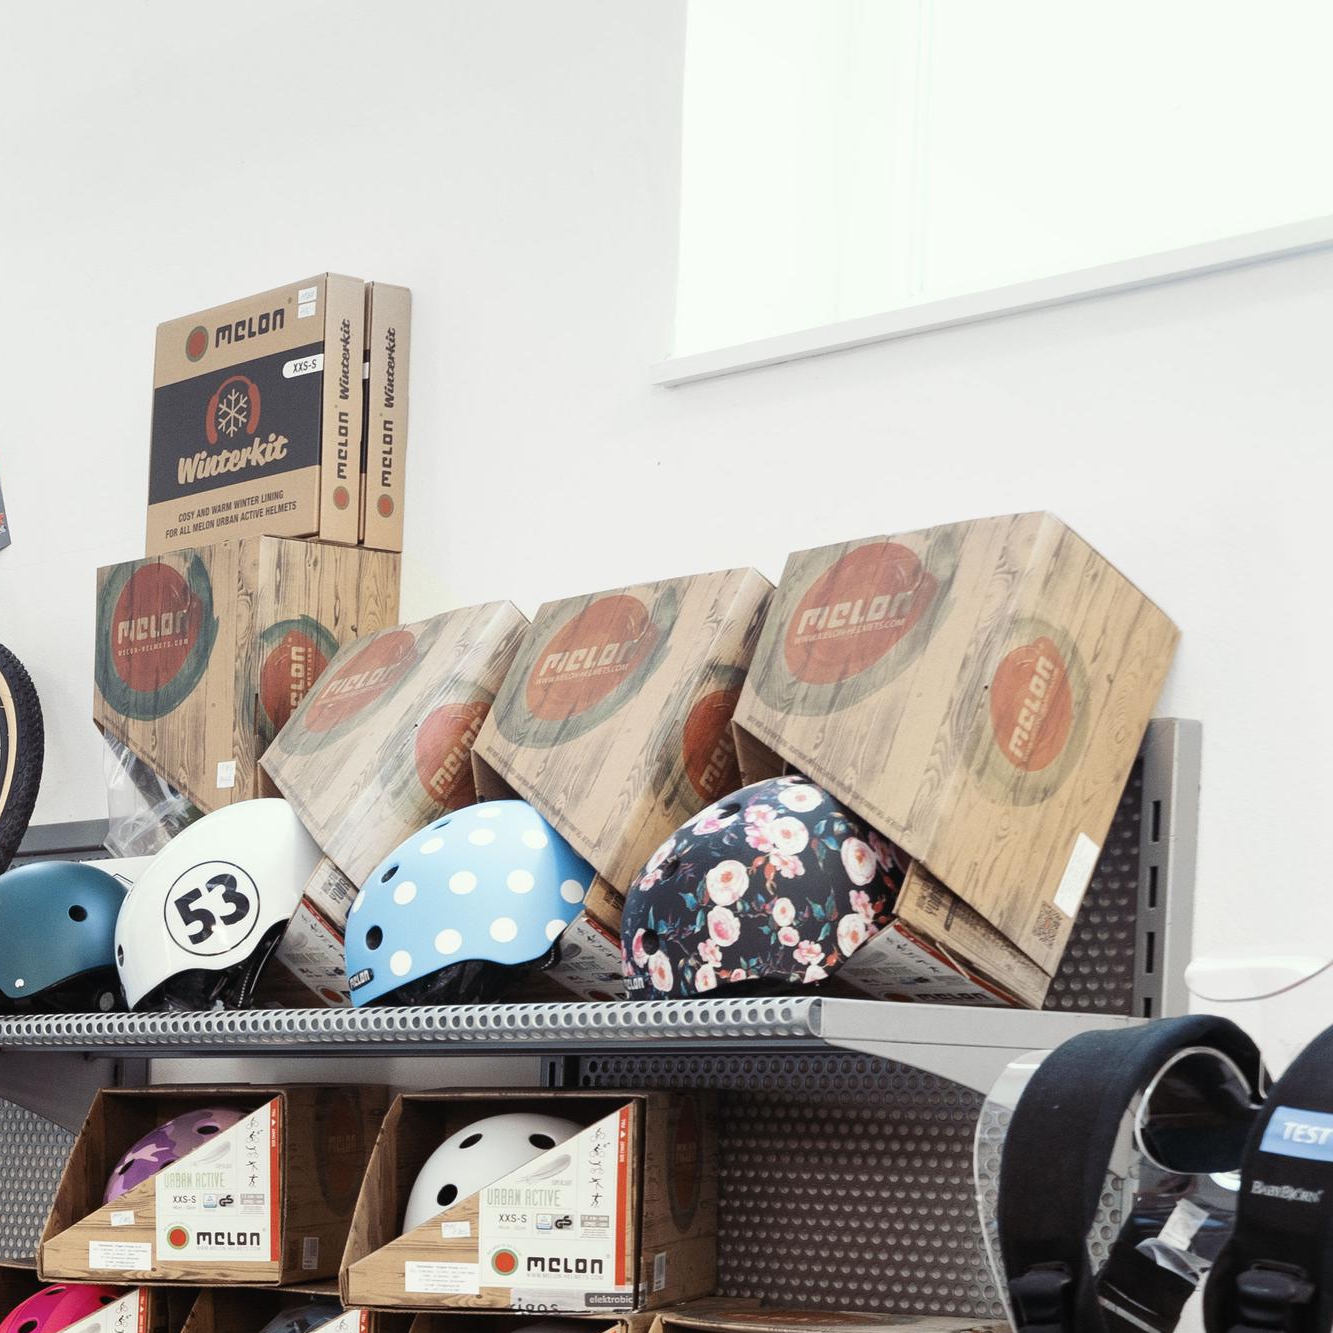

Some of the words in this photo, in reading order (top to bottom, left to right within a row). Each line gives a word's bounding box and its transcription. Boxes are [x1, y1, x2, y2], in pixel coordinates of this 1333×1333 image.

[215, 308, 285, 349] MELON
[292, 358, 318, 374] XXS-S
[338, 319, 351, 401] Winterkit
[383, 327, 396, 409] Winterkit
[176, 432, 289, 485] Winterkit
[336, 411, 349, 480] MELON
[381, 419, 393, 488] MELON
[165, 526, 179, 540] FOR
[180, 524, 191, 537] ALL
[192, 519, 215, 535] MELON
[216, 513, 239, 530] URBAN
[240, 507, 264, 525] ACTIVE
[265, 500, 297, 521] HELMETS
[178, 506, 197, 523] COSY
[197, 505, 210, 520] AND
[211, 501, 233, 518] WARM
[234, 495, 260, 514] WINTER
[261, 490, 284, 509] LINING
[117, 609, 189, 645] MELON
[797, 591, 913, 637] MELON
[290, 646, 306, 713] ELON
[1008, 653, 1056, 760] MELON
[174, 873, 253, 944] 53
[1283, 1120, 1333, 1145] TEST
[172, 1194, 197, 1204] XXS-S
[486, 1188, 521, 1205] URBAN
[525, 1189, 561, 1207] ACTIVE
[499, 1213, 527, 1223] XXS-S
[196, 1231, 261, 1246] MELON
[527, 1256, 603, 1274] MELON
